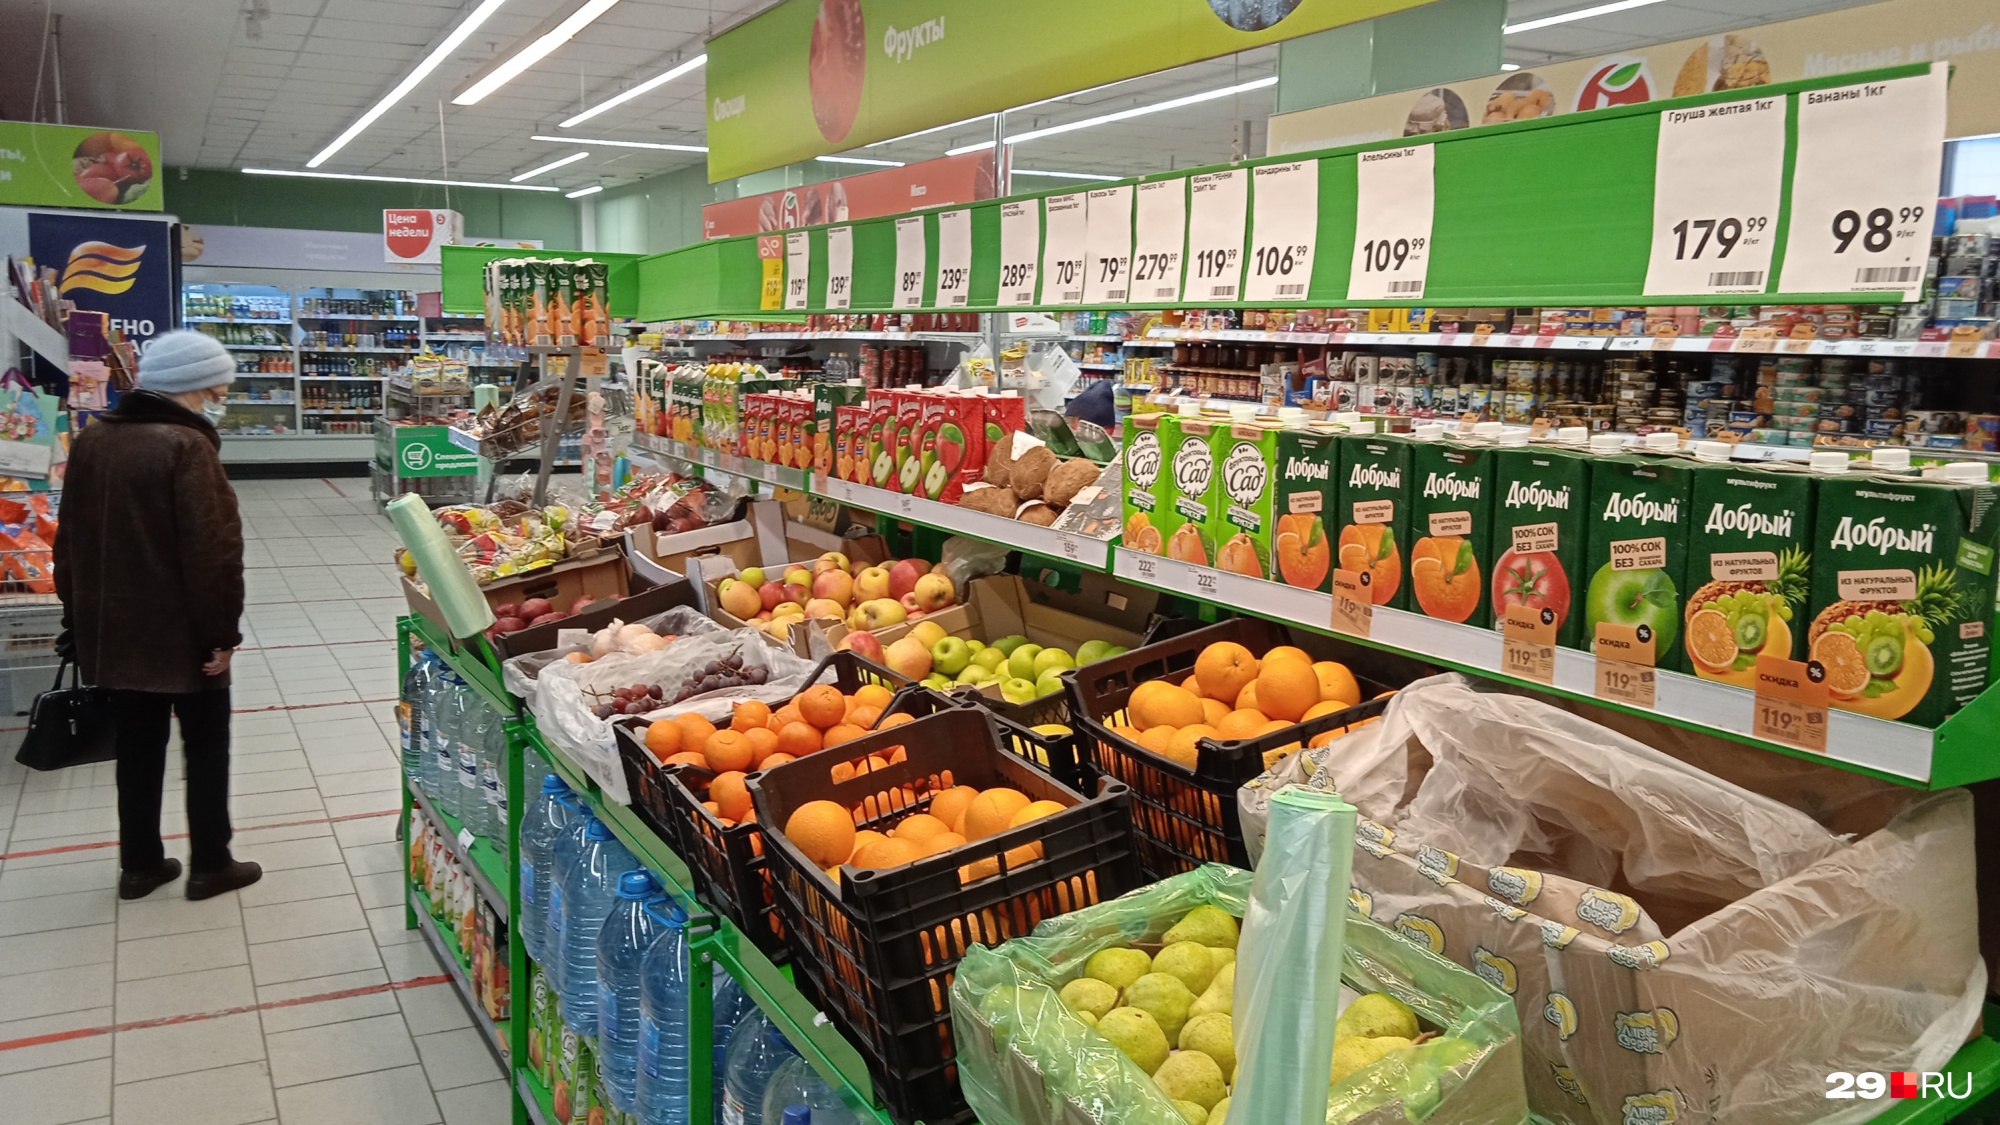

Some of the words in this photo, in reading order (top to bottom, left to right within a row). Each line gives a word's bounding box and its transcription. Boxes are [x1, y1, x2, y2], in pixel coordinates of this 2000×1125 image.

[884, 16, 945, 63] Фрукты
[1808, 88, 1860, 105] Бананы
[1863, 85, 1886, 98] 1кг
[1668, 108, 1705, 123] Груша
[1707, 102, 1752, 118] желтая
[1755, 99, 1774, 111] 1кг
[1362, 151, 1402, 163] Апельсины
[1404, 148, 1416, 156] 1кг
[1255, 165, 1291, 176] Мандарины
[388, 213, 417, 225] Цена
[389, 227, 429, 238] недели
[1672, 217, 1742, 260] 179
[1746, 216, 1768, 232] 99
[1832, 208, 1894, 254] 98
[1899, 206, 1925, 223] 99
[1197, 249, 1226, 278] 119
[1227, 249, 1237, 260] 99
[1256, 245, 1294, 276] 106
[1296, 245, 1308, 257] 99
[1363, 238, 1409, 272] 109
[1411, 238, 1425, 250] 99
[1002, 263, 1027, 287] 289
[1056, 260, 1074, 285] 70
[1100, 257, 1119, 283] 79
[1119, 257, 1128, 267] 99
[1135, 253, 1169, 280] 279
[1169, 253, 1178, 263] 99
[790, 279, 802, 296] 119
[831, 276, 845, 295] 139
[902, 271, 915, 291] 89
[941, 268, 961, 290] 239
[1132, 451, 1159, 476] Сад
[1179, 458, 1211, 484] Сад
[1285, 456, 1329, 482] Добрый
[1230, 465, 1264, 492] Сад
[1349, 463, 1400, 491] Добрый
[1423, 471, 1480, 501] Добрый
[1727, 478, 1777, 490] мультифрукт
[1505, 480, 1569, 511] Добрый
[1856, 489, 1915, 502] мультифрукт
[1603, 491, 1678, 525] Добрый
[1704, 502, 1793, 539] Добрый
[1515, 529, 1536, 538] 100%
[1537, 526, 1554, 536] СОК
[1830, 516, 1934, 555] Добрый
[1516, 542, 1532, 551] БЕЗ
[1613, 543, 1639, 554] 100%
[1640, 541, 1661, 552] СОК
[1139, 560, 1151, 573] 222
[1615, 558, 1634, 568] БЕЗ
[1724, 558, 1775, 566] НАТУРАЛЬНЫХ
[1729, 567, 1763, 575] ФРУКТОВ
[1198, 574, 1213, 588] 222
[1853, 576, 1913, 585] НАТУРАЛЬНЫХ
[1859, 587, 1897, 595] ФРУКТОВ
[1507, 618, 1535, 630] скидка
[1598, 637, 1631, 649] скидка
[1509, 648, 1530, 665] 119
[1605, 670, 1629, 689] 119
[1760, 672, 1799, 689] скидка
[1761, 707, 1793, 729] 119
